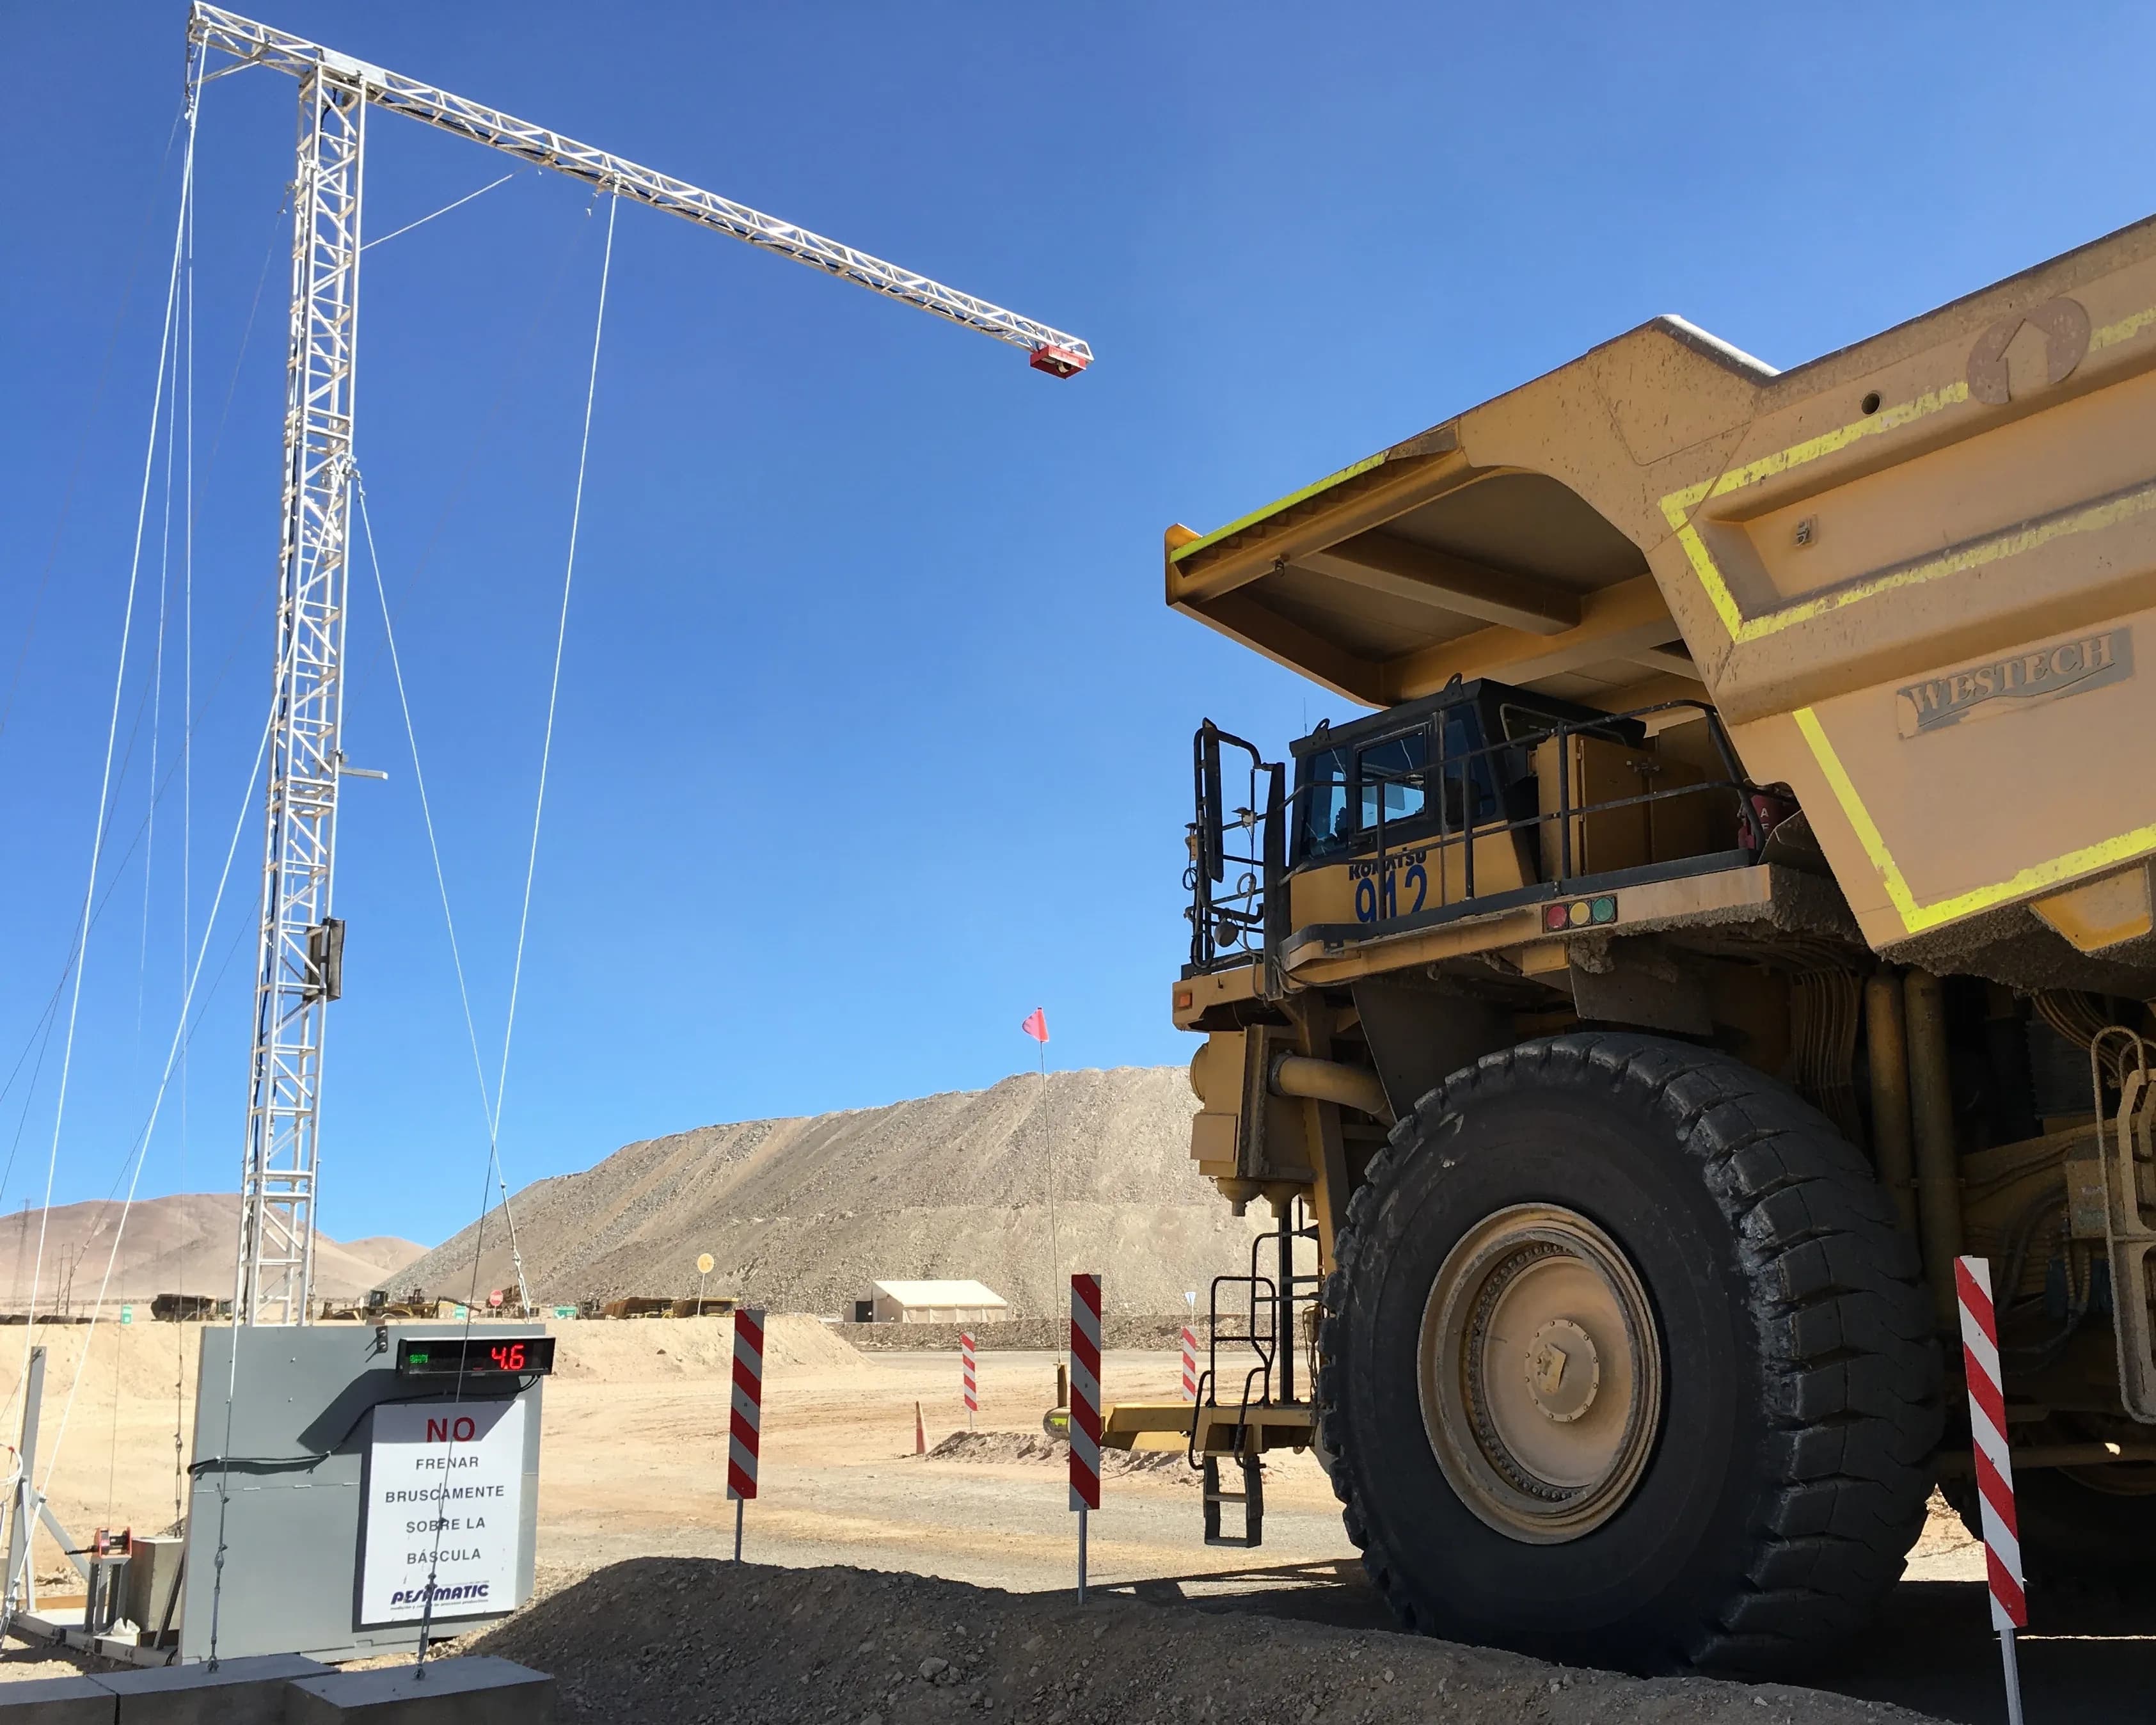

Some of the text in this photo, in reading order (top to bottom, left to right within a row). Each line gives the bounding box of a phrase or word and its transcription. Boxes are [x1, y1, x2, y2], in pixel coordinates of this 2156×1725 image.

[1908, 632, 2114, 714] WESTECH
[1761, 807, 1769, 818] A
[1355, 864, 1427, 923] 912
[491, 1344, 525, 1370] 4.6
[427, 1417, 475, 1443] NO
[416, 1456, 479, 1470] FRENAR
[385, 1486, 505, 1504] BRUSCAMENTE
[406, 1517, 486, 1534] SOBRE LA
[407, 1548, 481, 1565] BÁSCULA
